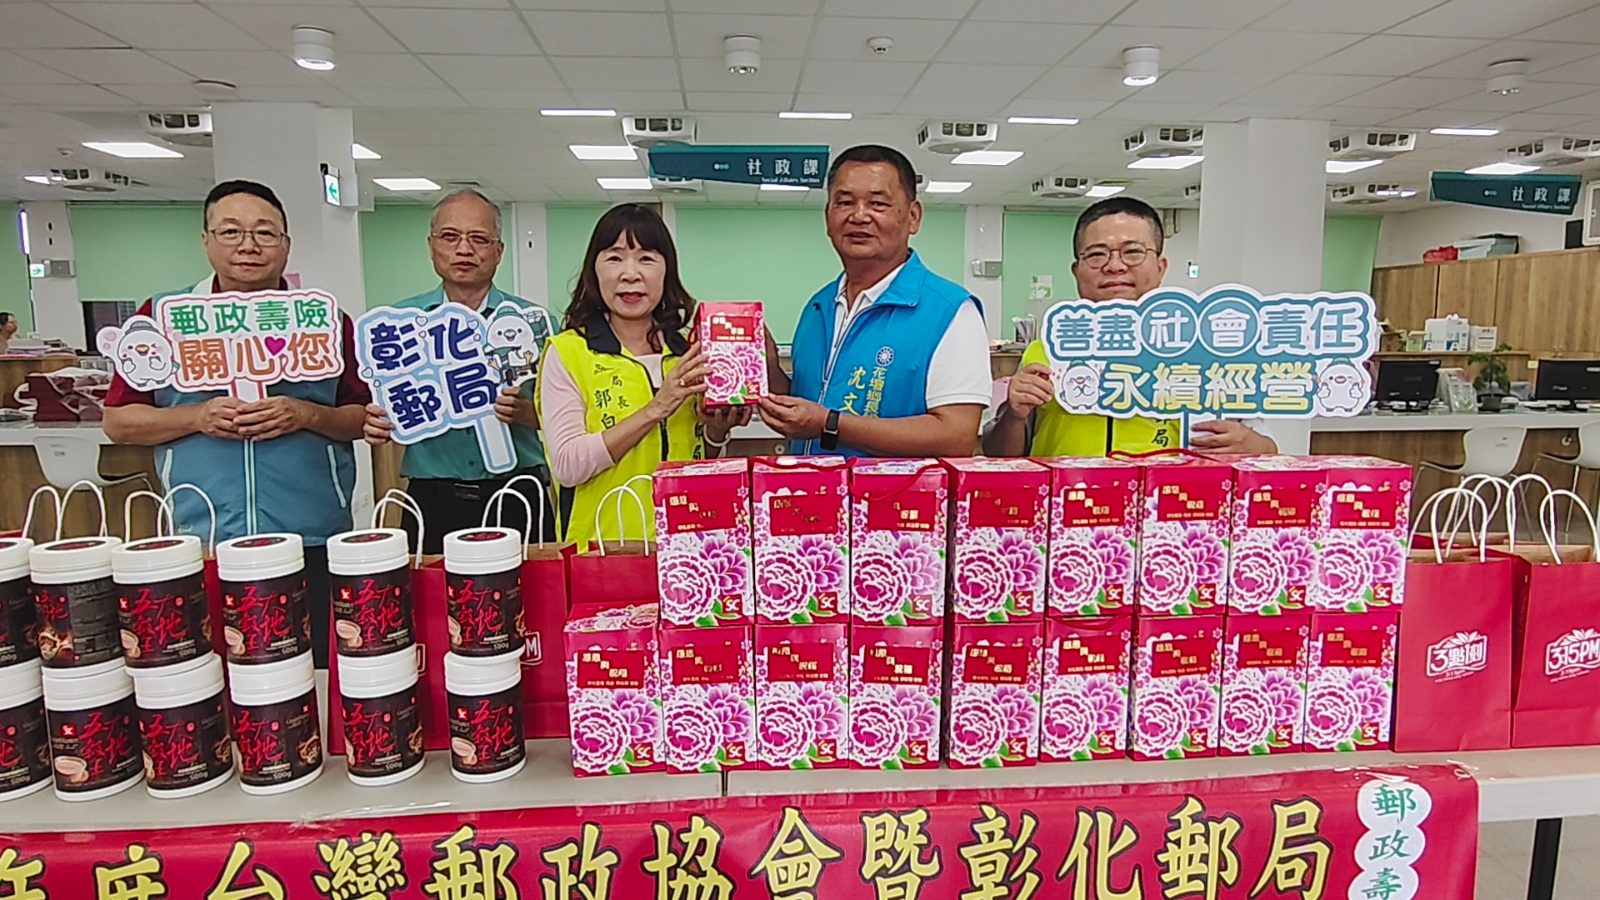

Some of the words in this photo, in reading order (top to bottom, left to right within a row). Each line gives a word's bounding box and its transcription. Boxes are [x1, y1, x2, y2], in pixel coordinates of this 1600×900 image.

[747, 158, 819, 176] 社政課
[1512, 186, 1571, 203] 社政課
[169, 298, 330, 336] 郵政壽險
[1056, 306, 1358, 352] 善盡社會責任
[178, 333, 335, 383] 關心您
[369, 316, 481, 371] 彰化
[388, 367, 498, 431] 郵局
[1103, 360, 1317, 411] 永續經營
